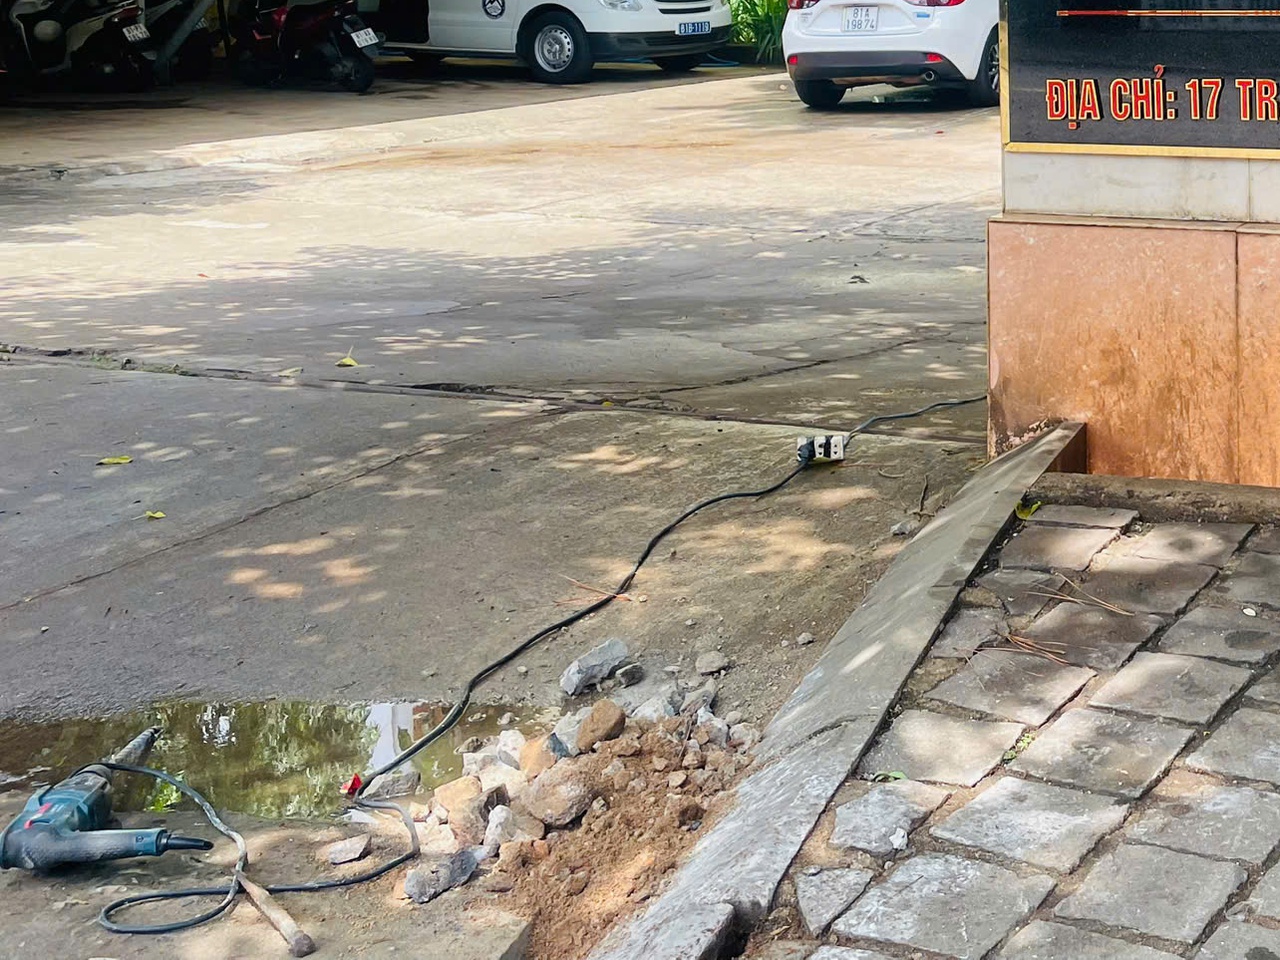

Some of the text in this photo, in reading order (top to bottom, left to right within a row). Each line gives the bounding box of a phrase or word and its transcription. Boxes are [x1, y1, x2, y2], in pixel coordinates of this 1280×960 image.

[852, 7, 870, 18] 81A
[1046, 79, 1101, 130] ĐỊA
[1109, 64, 1175, 121] CHỈ:
[1185, 78, 1221, 120] 17
